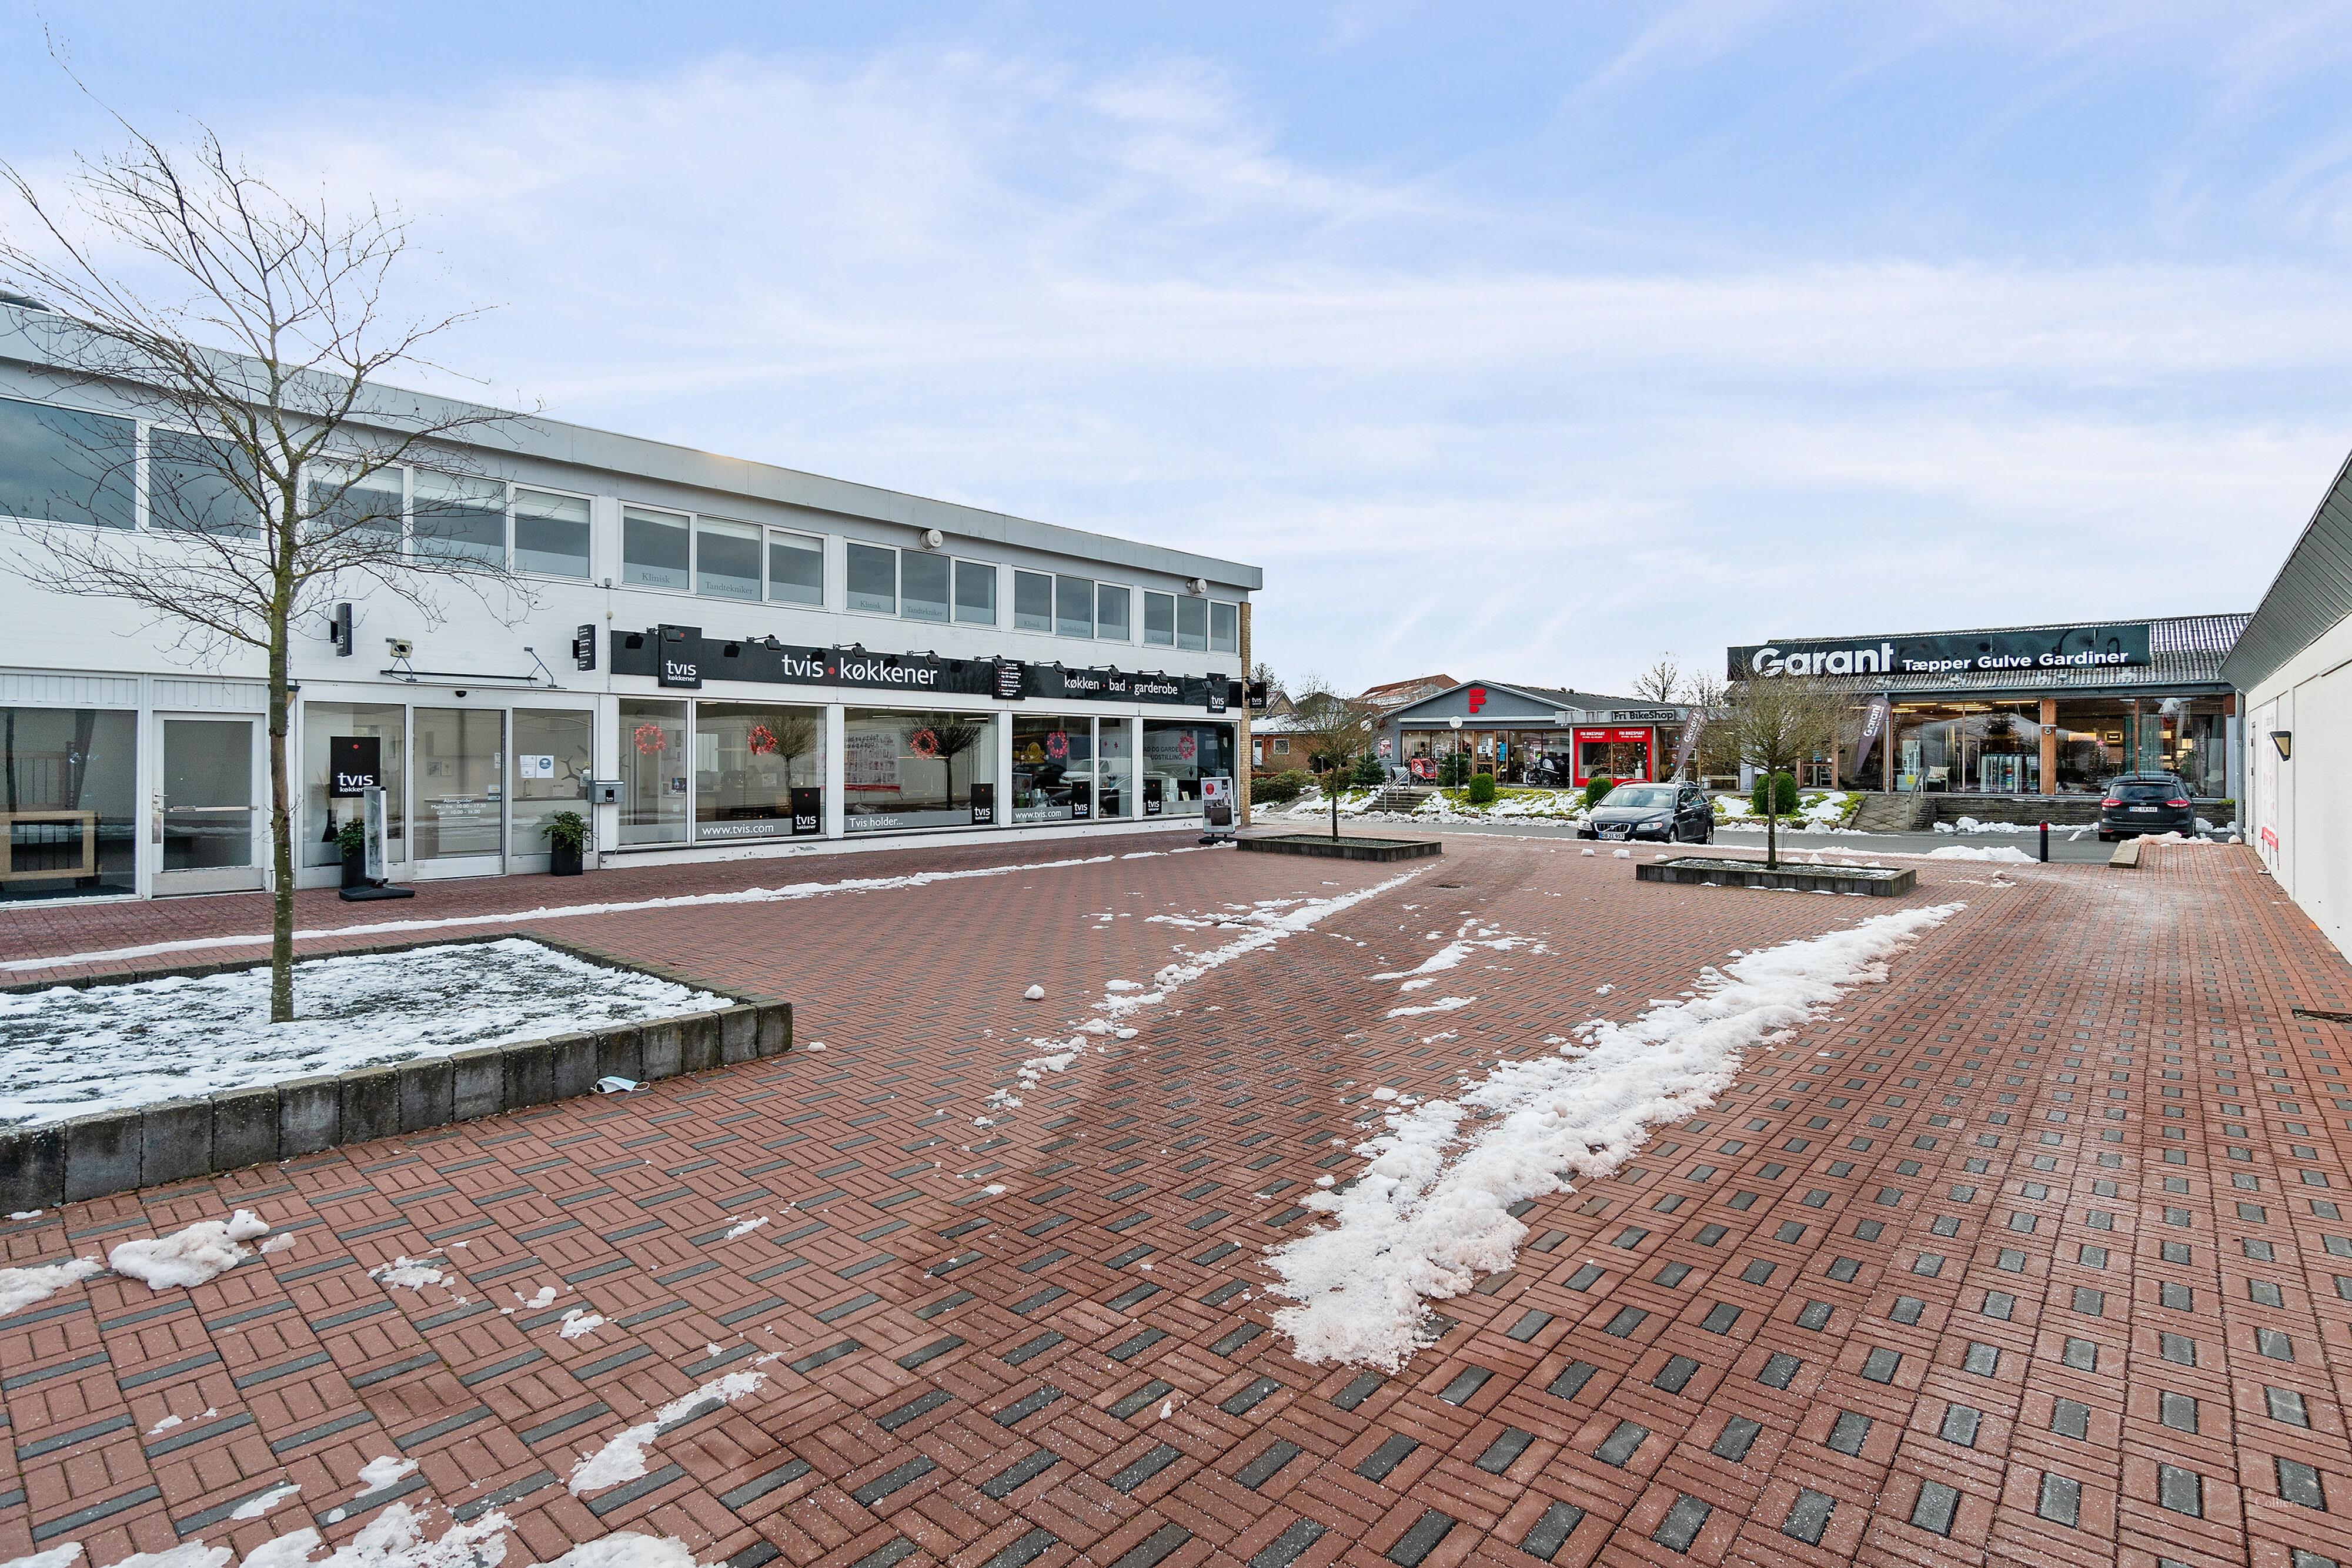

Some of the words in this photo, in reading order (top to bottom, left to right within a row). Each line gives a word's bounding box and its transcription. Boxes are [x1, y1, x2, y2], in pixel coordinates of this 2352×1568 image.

[642, 573, 670, 583] Klinisk
[706, 581, 753, 594] Tandtekniker
[860, 601, 881, 609] Klinisk
[907, 606, 943, 616] Tandtekniker
[1752, 643, 1894, 677] Garant
[1902, 658, 1971, 672] Tæpper
[1977, 654, 2032, 667] Gulve
[2039, 651, 2129, 666] Gardiner
[666, 660, 697, 676] tvis
[781, 654, 824, 678] tvis
[840, 657, 938, 684] køkkener
[1064, 675, 1099, 690] køkken
[1109, 678, 1125, 691] bad
[1134, 681, 1178, 696] garderobe
[1211, 695, 1224, 705] tvis
[1614, 711, 1626, 720] Fri
[1629, 710, 1673, 720] BikeShop
[1863, 704, 1883, 737] Garant
[338, 772, 374, 786] tvis
[1074, 803, 1088, 811] tvis
[1148, 800, 1160, 808] tvis
[974, 807, 990, 816] tvis
[1015, 810, 1062, 819] www.tvis.com
[796, 814, 817, 825] tvis
[849, 818, 867, 828] Tvis
[702, 824, 774, 835] www.tvis.com
